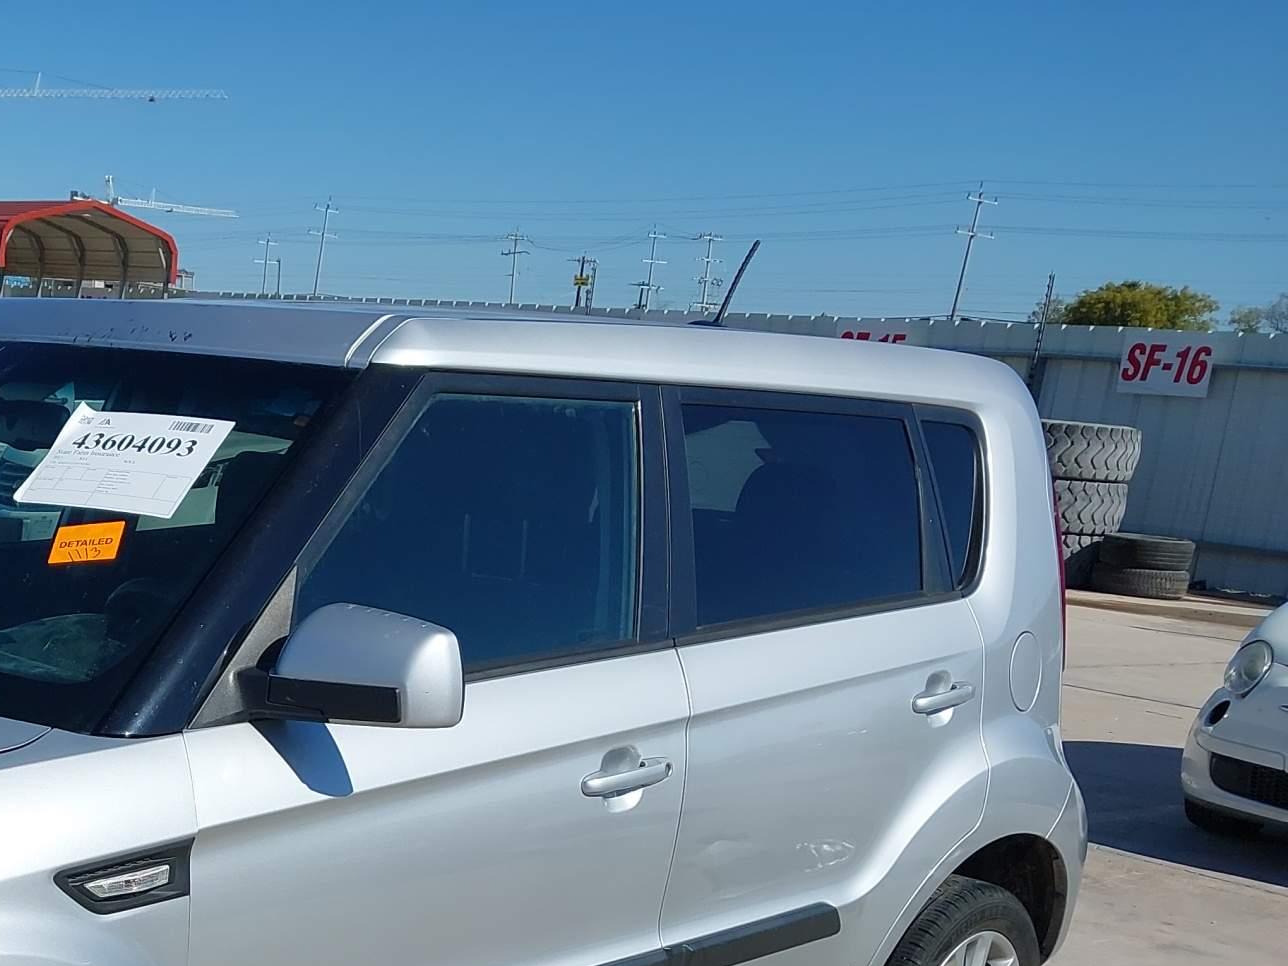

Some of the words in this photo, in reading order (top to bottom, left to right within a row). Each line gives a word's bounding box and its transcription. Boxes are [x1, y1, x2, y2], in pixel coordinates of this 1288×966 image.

[1121, 342, 1212, 385] SF-16
[72, 432, 198, 457] 43604093
[59, 537, 114, 548] DETAILED
